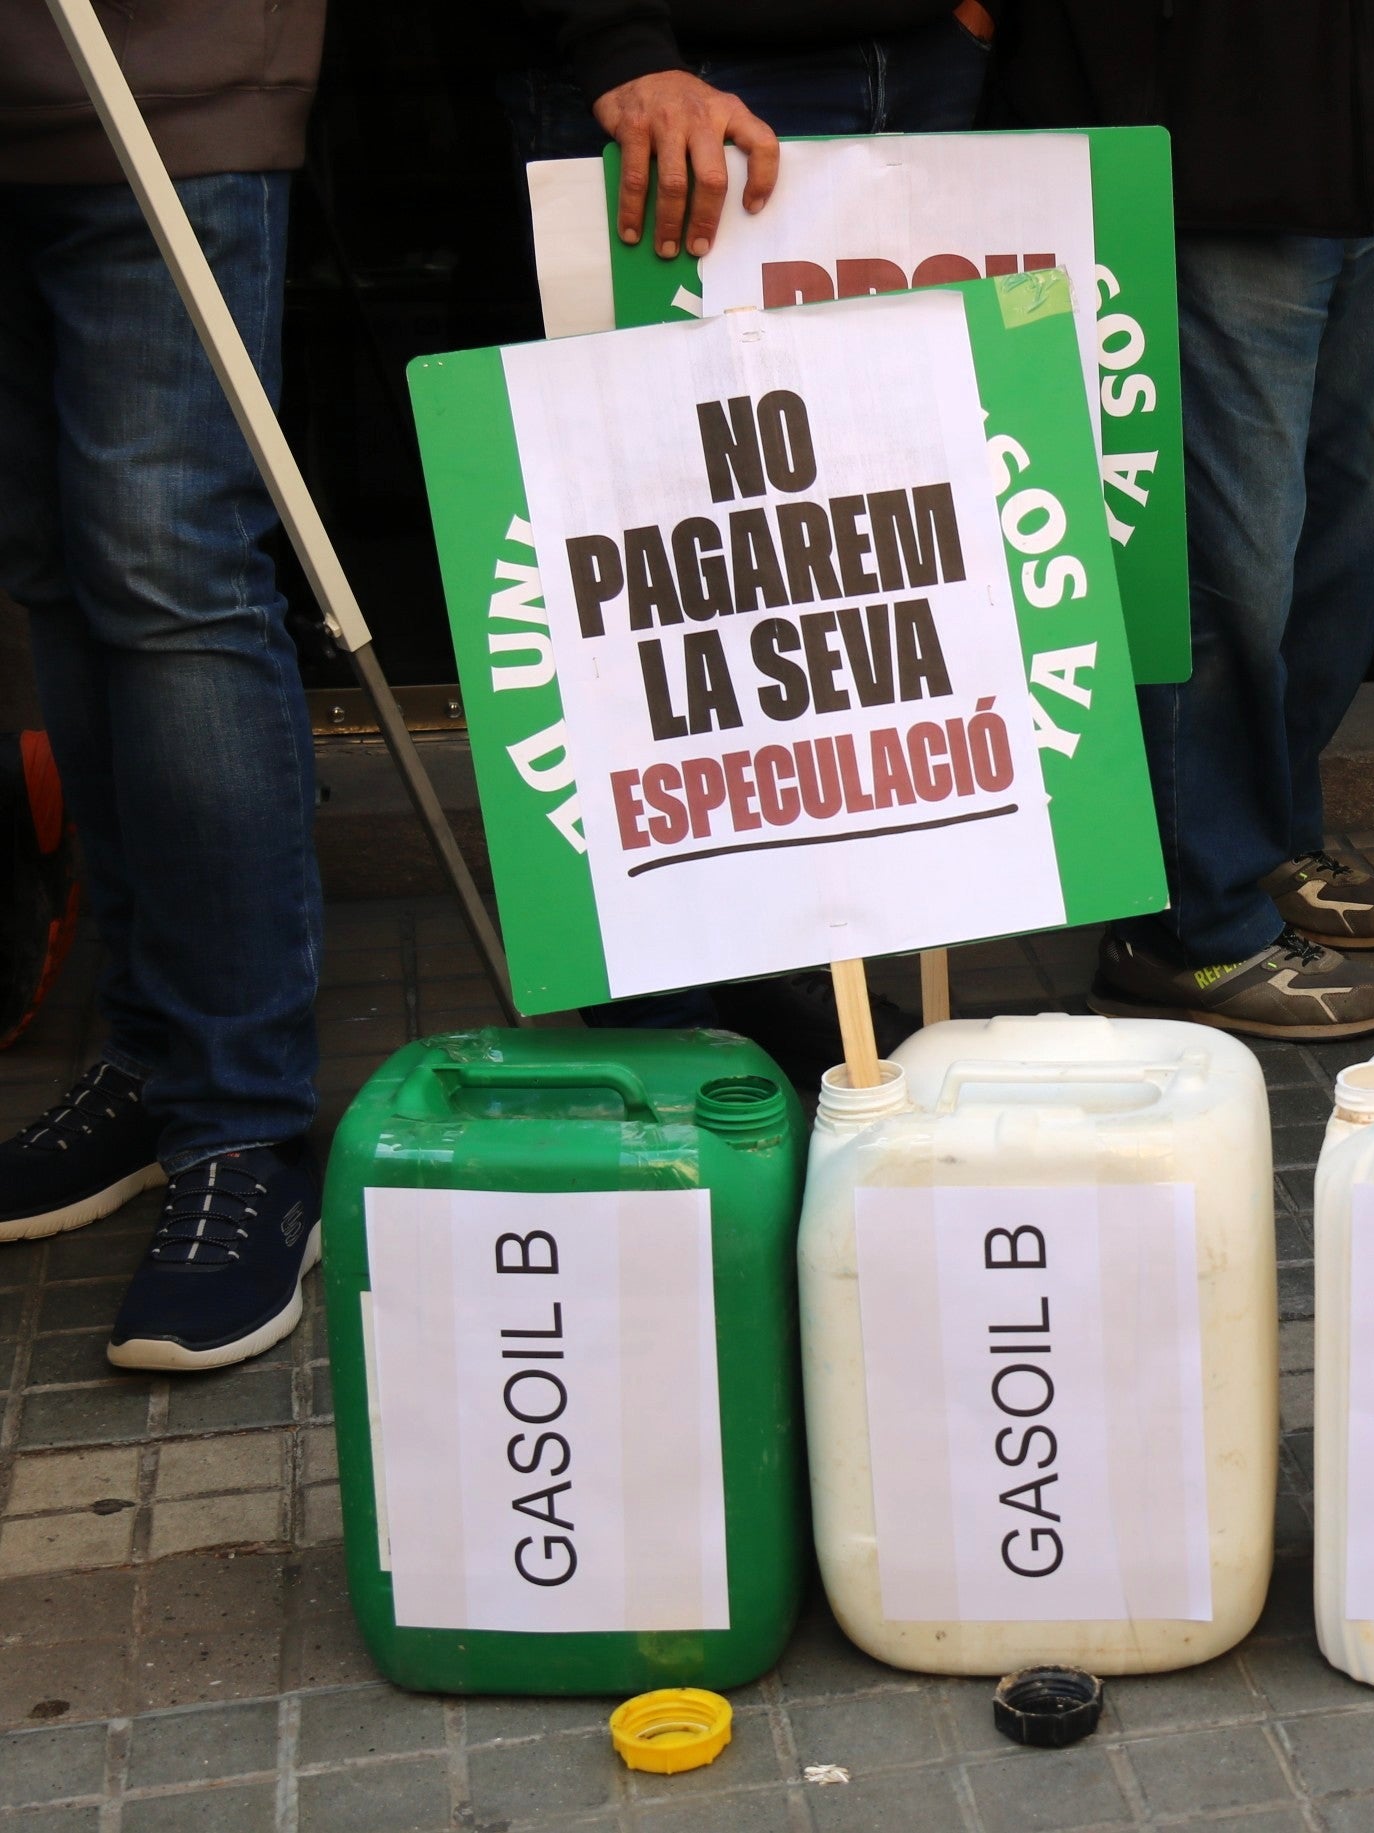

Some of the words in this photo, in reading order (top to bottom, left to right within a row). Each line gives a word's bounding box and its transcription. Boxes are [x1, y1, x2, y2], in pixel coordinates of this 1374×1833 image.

[696, 390, 816, 503] NO
[566, 483, 966, 638] PAGAREM
[638, 628, 743, 741] LA
[748, 598, 953, 721] SEVA
[611, 697, 1013, 850] ESPECULACIÓ
[496, 1230, 559, 1274] B
[985, 1225, 1046, 1269] B
[501, 1302, 577, 1586] GASOIL
[989, 1297, 1063, 1577] GASOIL
